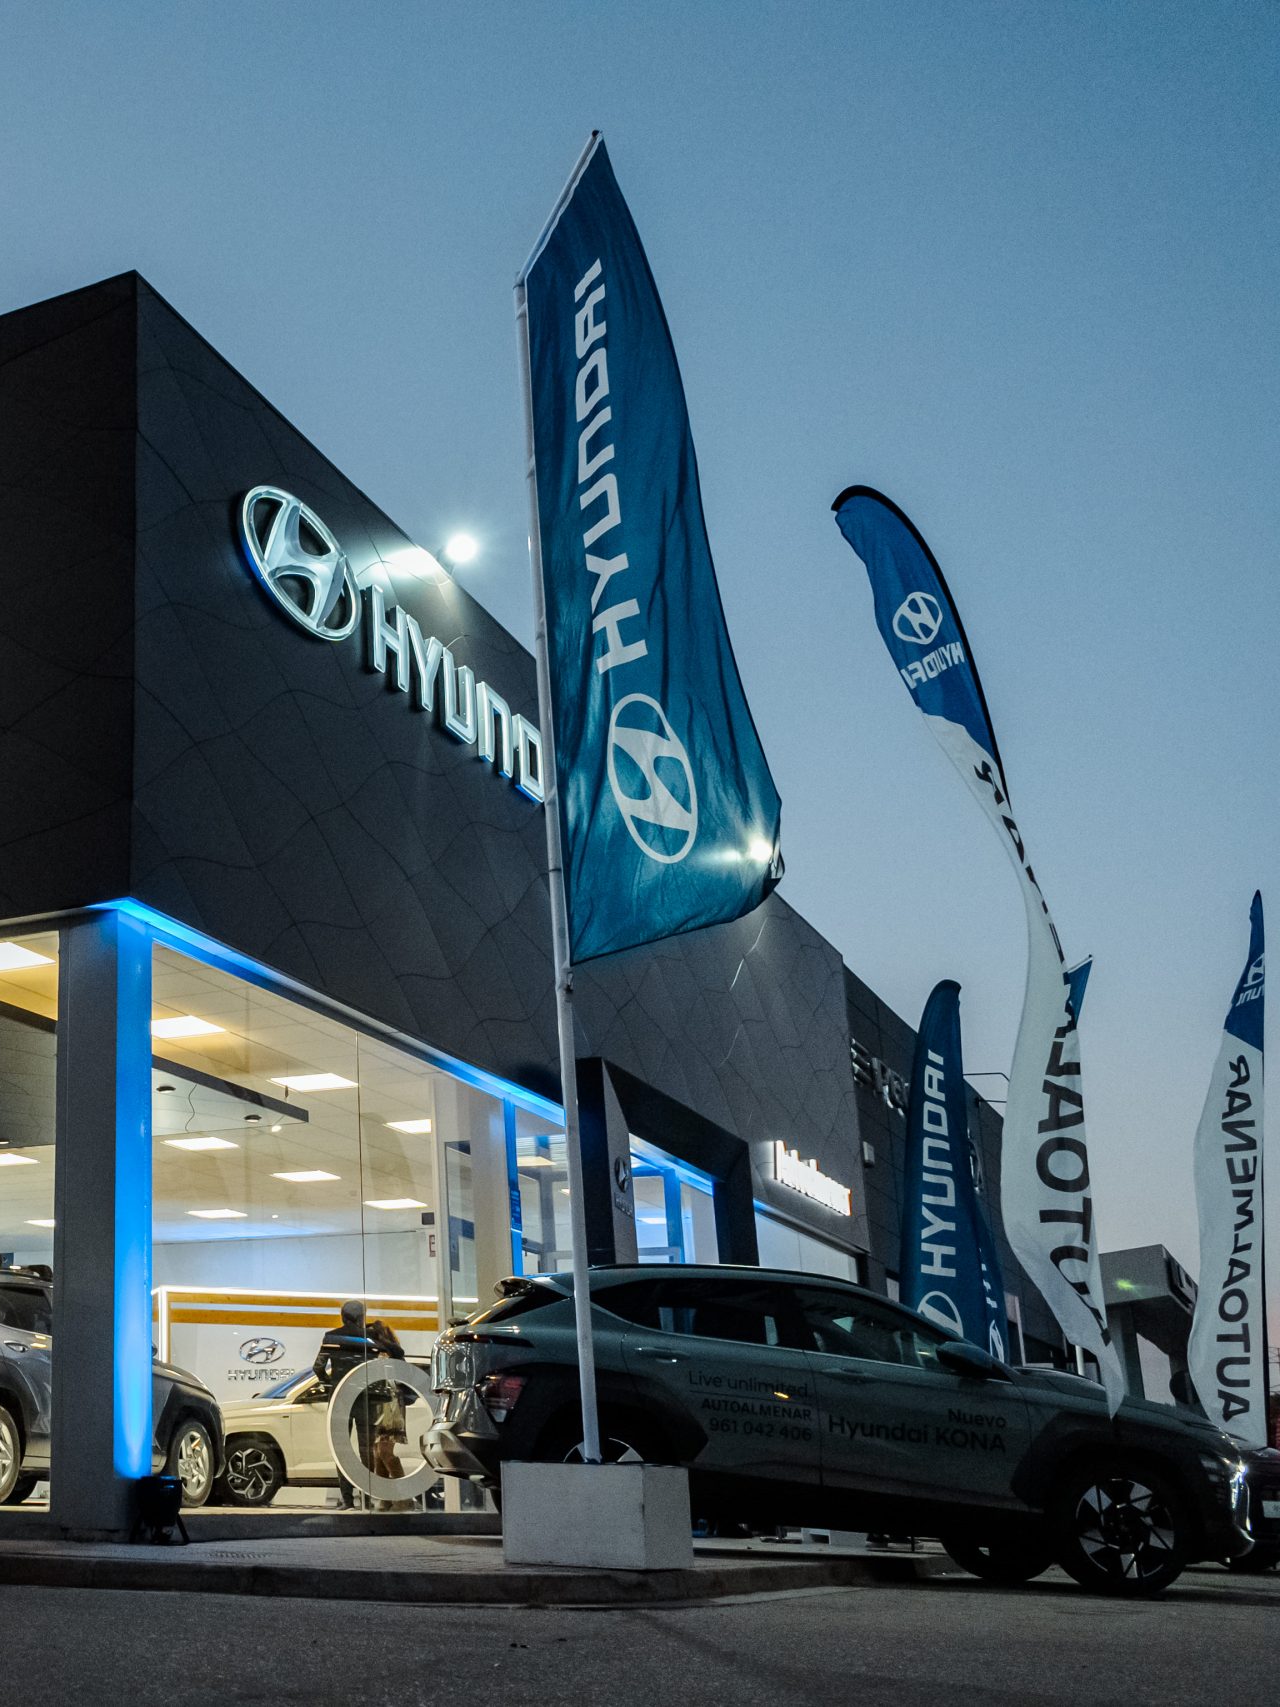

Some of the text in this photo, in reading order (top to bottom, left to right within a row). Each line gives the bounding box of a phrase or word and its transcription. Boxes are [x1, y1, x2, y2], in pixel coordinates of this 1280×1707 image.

[574, 258, 648, 675] HYUNDAI
[366, 583, 545, 803] HYUND
[920, 1048, 956, 1278] HYUNDAI
[688, 1371, 722, 1388] Live
[701, 1398, 812, 1421] AUTOALMENAR
[947, 1408, 1007, 1429] Nuevo
[709, 1417, 813, 1441] 961 042 406
[828, 1414, 1007, 1453] Hyundai KONA
